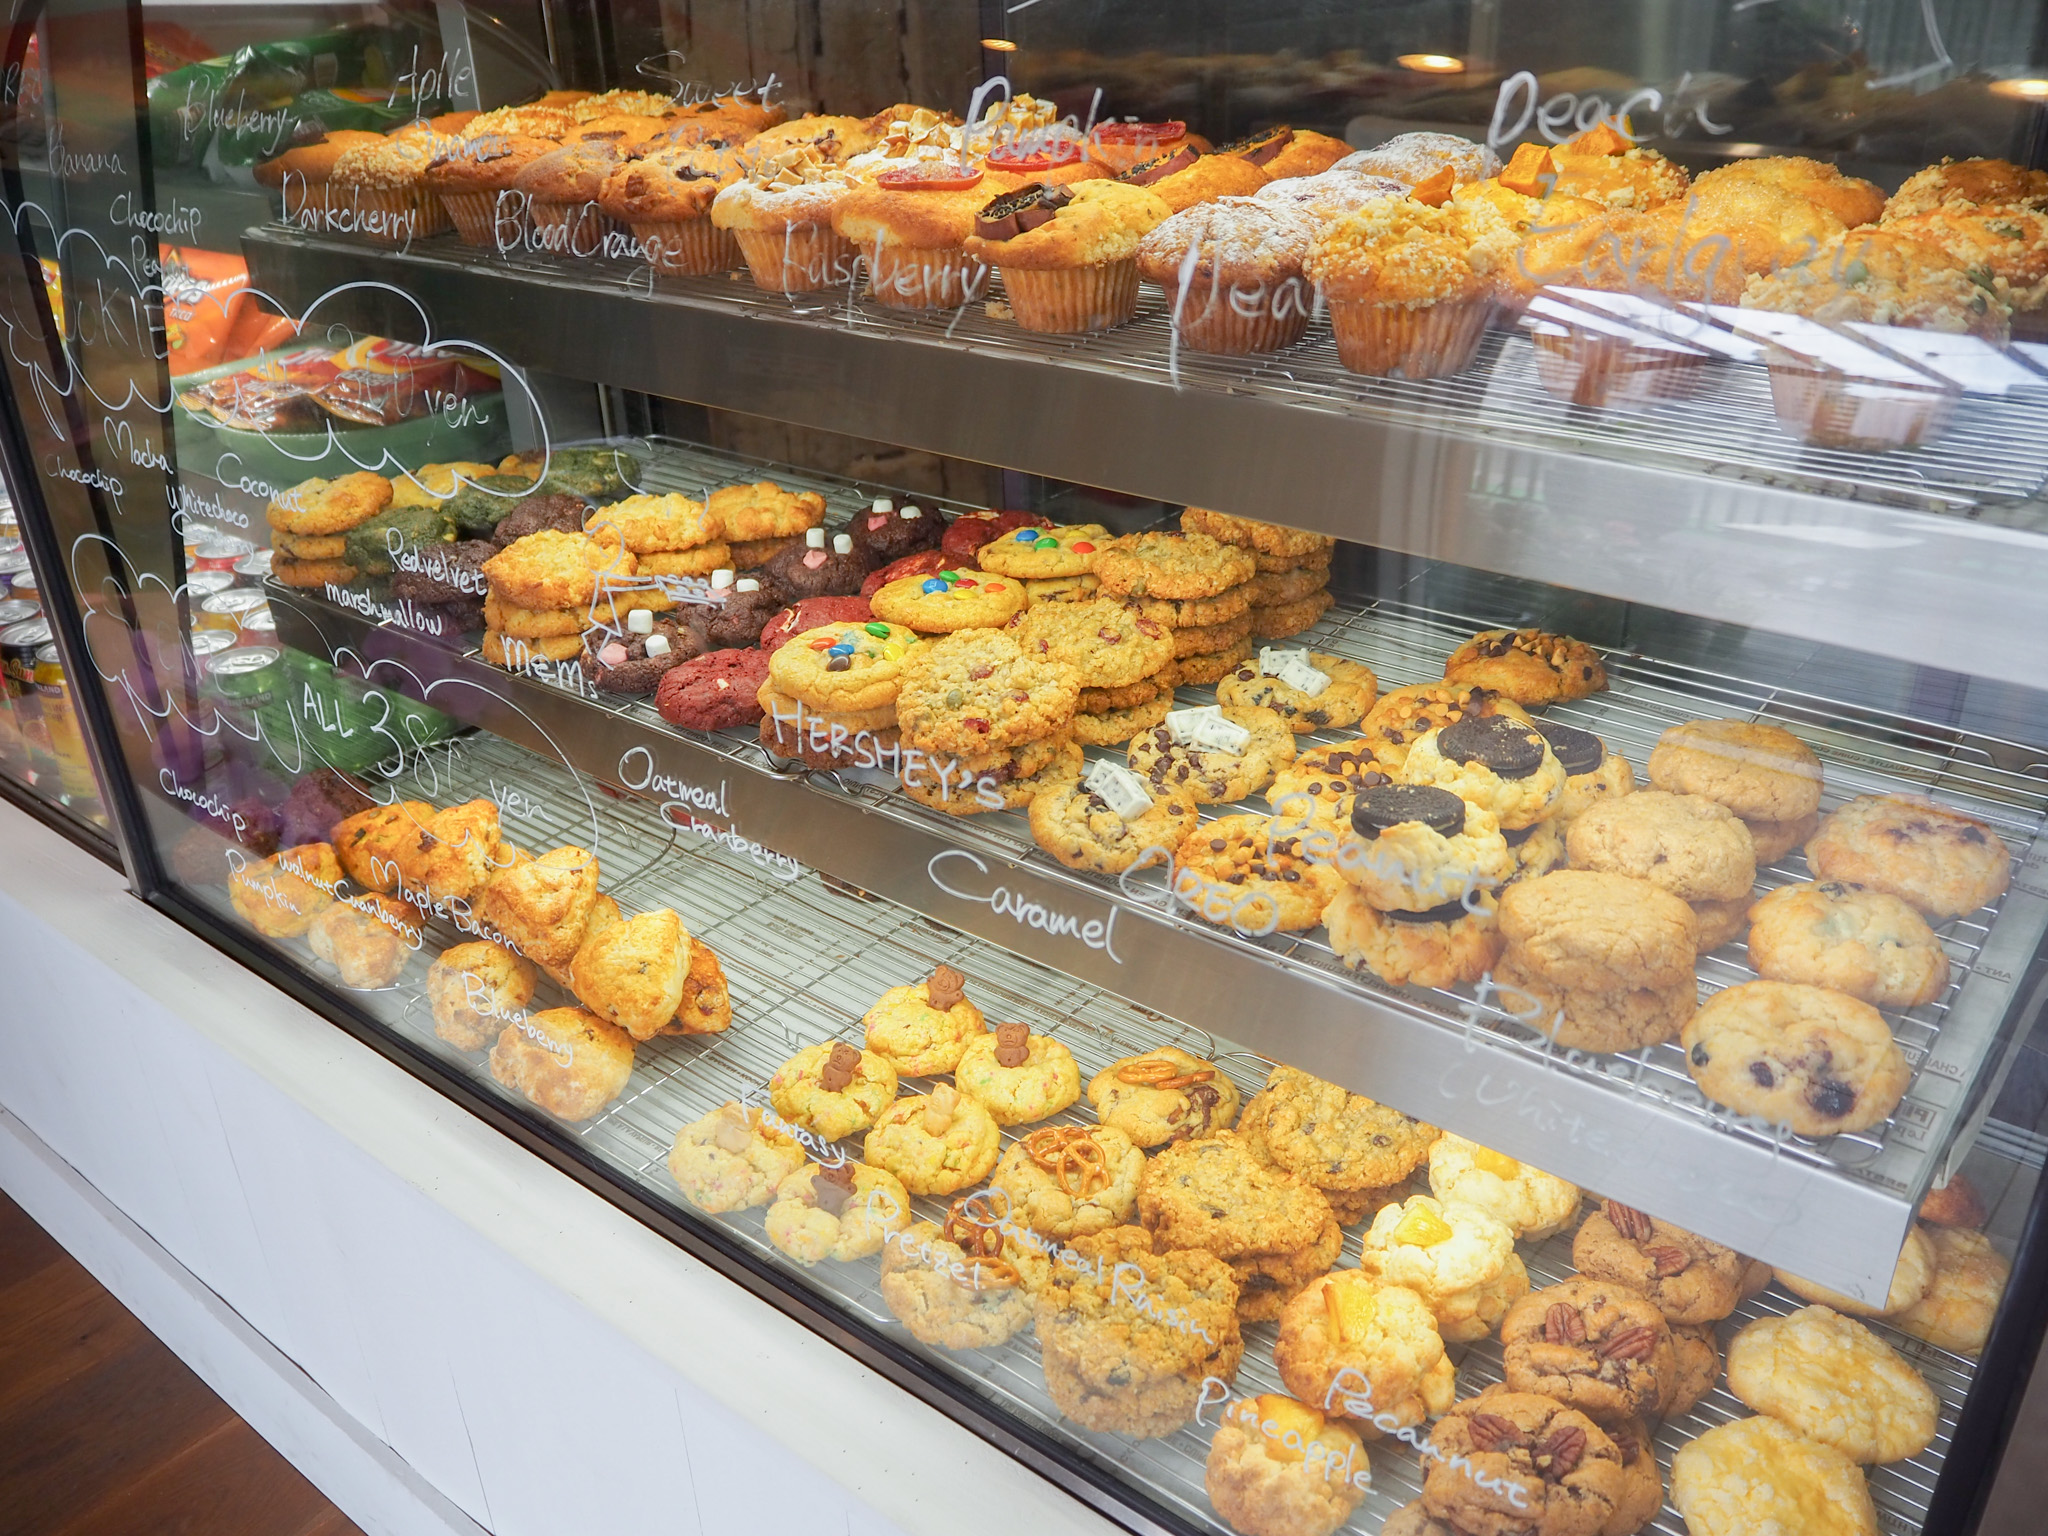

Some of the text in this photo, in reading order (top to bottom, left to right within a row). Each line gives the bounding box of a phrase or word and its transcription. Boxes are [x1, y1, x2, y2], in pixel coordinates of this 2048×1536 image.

[184, 75, 298, 156] Blueberry
[636, 50, 784, 113] Sweet
[1484, 70, 1733, 180] Peach
[110, 191, 201, 244] Chocochip
[281, 169, 416, 257] Darkcherry
[45, 454, 123, 515] Chocochip
[216, 452, 306, 512] Coconut
[303, 681, 354, 738] ALL
[617, 745, 730, 819] Oatmeal
[224, 848, 302, 915] Pumpkin
[660, 801, 800, 882] Cranberry
[1267, 792, 1501, 917] Peanut
[370, 855, 523, 956] Maple Bacon
[927, 848, 1123, 966] Caramel
[461, 970, 574, 1069] Blueberry
[739, 1082, 847, 1168] Fantasy
[866, 1190, 980, 1291] Pretzel
[963, 1186, 1215, 1346] Oatmeal Raisin
[1195, 1376, 1378, 1495] Pineapple
